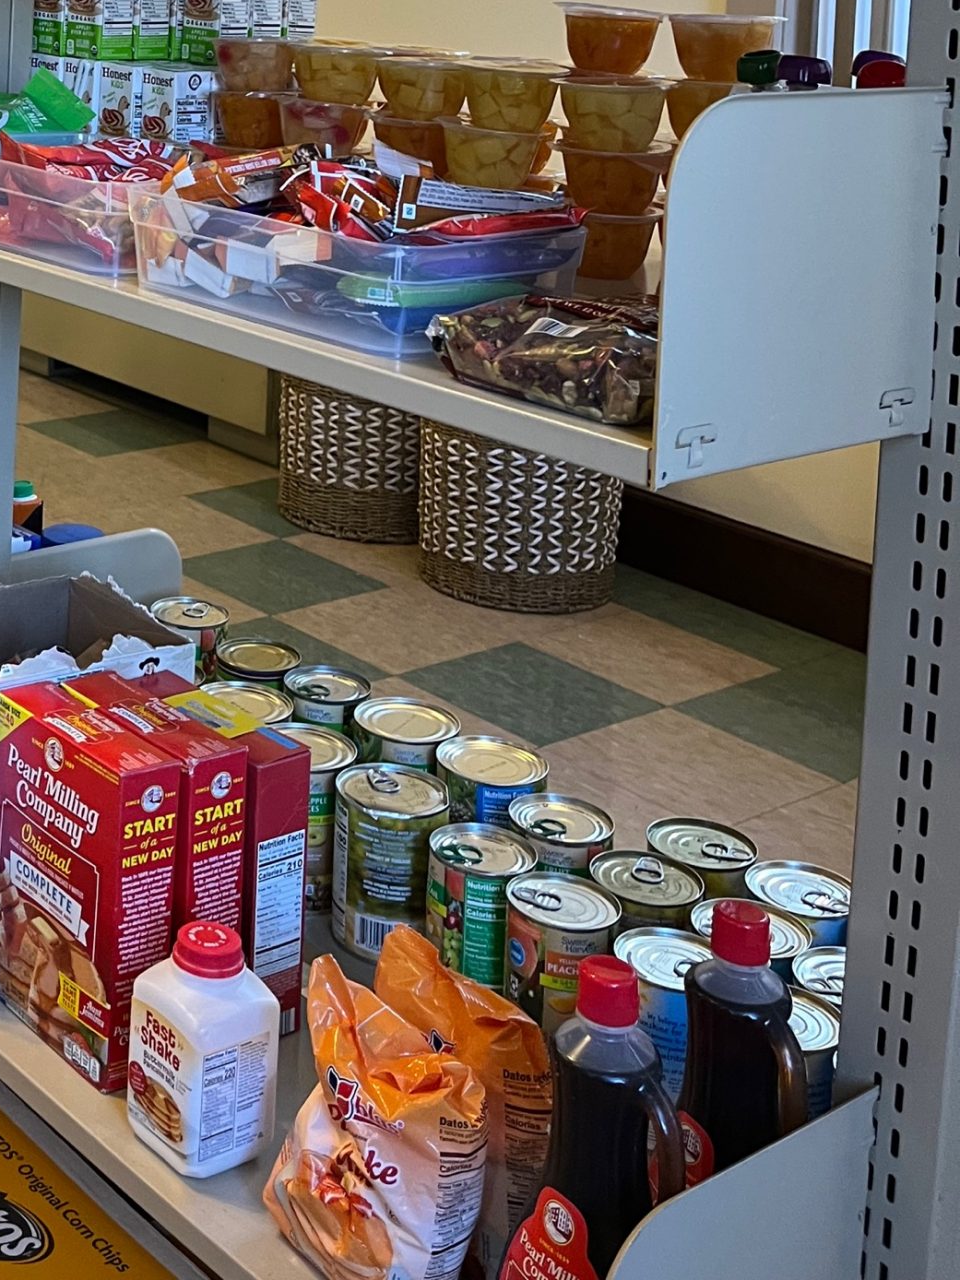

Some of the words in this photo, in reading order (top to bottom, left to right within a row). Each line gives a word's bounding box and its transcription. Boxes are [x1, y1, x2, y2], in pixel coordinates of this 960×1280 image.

[33, 11, 59, 20] ORGANIC
[70, 14, 96, 24] ORGANIC
[185, 19, 214, 28] ORGANIC
[102, 66, 133, 82] Honest
[143, 73, 174, 88] Honest
[51, 718, 83, 740] COMPLETE
[7, 742, 43, 790] Pearl
[43, 770, 101, 836] Milling
[484, 789, 512, 800] Nutrition
[16, 779, 85, 849] Company
[194, 798, 245, 826] START
[123, 813, 176, 840] START
[210, 824, 219, 835] of
[220, 823, 227, 831] a
[21, 822, 72, 876] Original
[140, 839, 150, 850] of
[150, 838, 157, 847] a
[192, 838, 220, 854] NEW
[221, 830, 244, 846] DAY
[258, 838, 286, 852] Nutrition
[287, 832, 304, 845] Facts
[122, 853, 150, 869] NEW
[151, 846, 175, 862] DAY
[258, 869, 283, 881] Calories
[286, 858, 304, 872] 210
[16, 859, 73, 915] COMPLETE
[466, 880, 501, 892] Nutrition
[466, 908, 497, 920] Calories
[561, 935, 589, 947] Sweet
[565, 942, 601, 954] Harvest
[78, 1007, 106, 1029] Jemima
[85, 1000, 103, 1018] Aunt
[145, 1010, 177, 1050] Fast
[140, 1026, 182, 1072] Shake
[142, 1058, 165, 1081] Pancake
[164, 1075, 176, 1091] Mix
[143, 1048, 177, 1082] Buttermilk
[203, 1075, 224, 1089] Calories
[224, 1068, 236, 1081] 220
[503, 1069, 530, 1083] Datos
[440, 1116, 468, 1130] Datos
[17, 1163, 69, 1212] Original
[61, 1207, 94, 1241] Corn
[92, 1236, 130, 1273] Chips
[519, 1227, 545, 1267] Pearl
